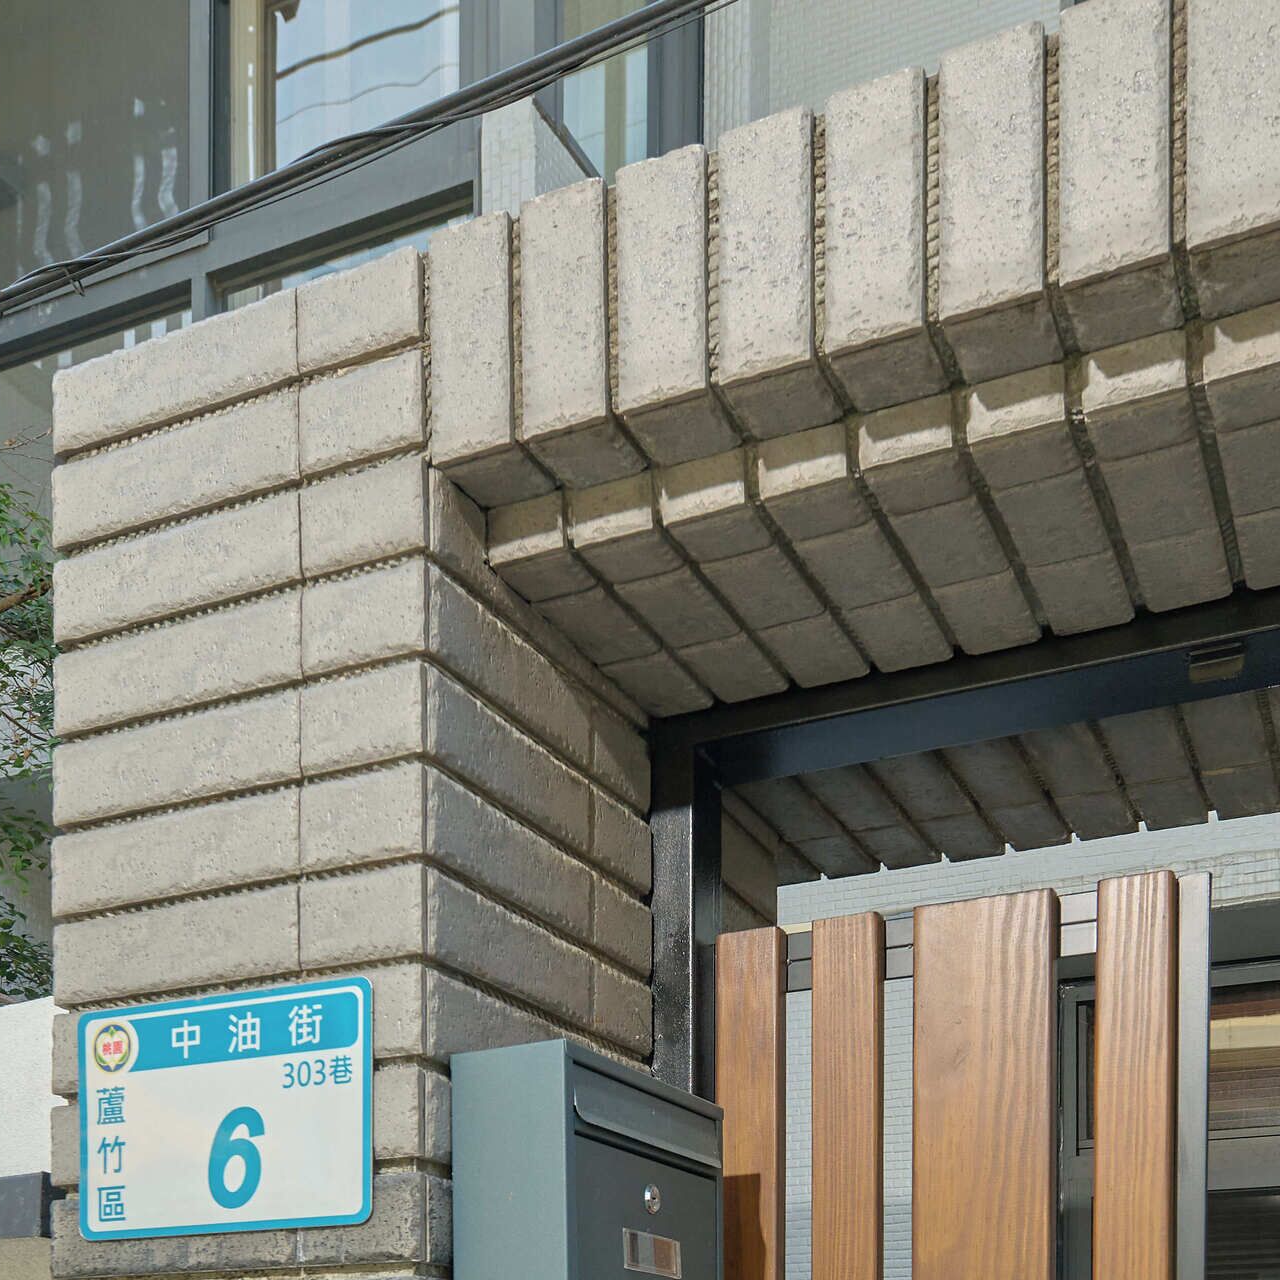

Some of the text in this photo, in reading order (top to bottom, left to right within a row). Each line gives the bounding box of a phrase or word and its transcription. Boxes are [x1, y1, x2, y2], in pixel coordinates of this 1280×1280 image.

[171, 1004, 323, 1059] 中油街
[282, 1055, 353, 1089] 303巷
[96, 1086, 126, 1222] 蘆竹區
[208, 1106, 265, 1209] 6
